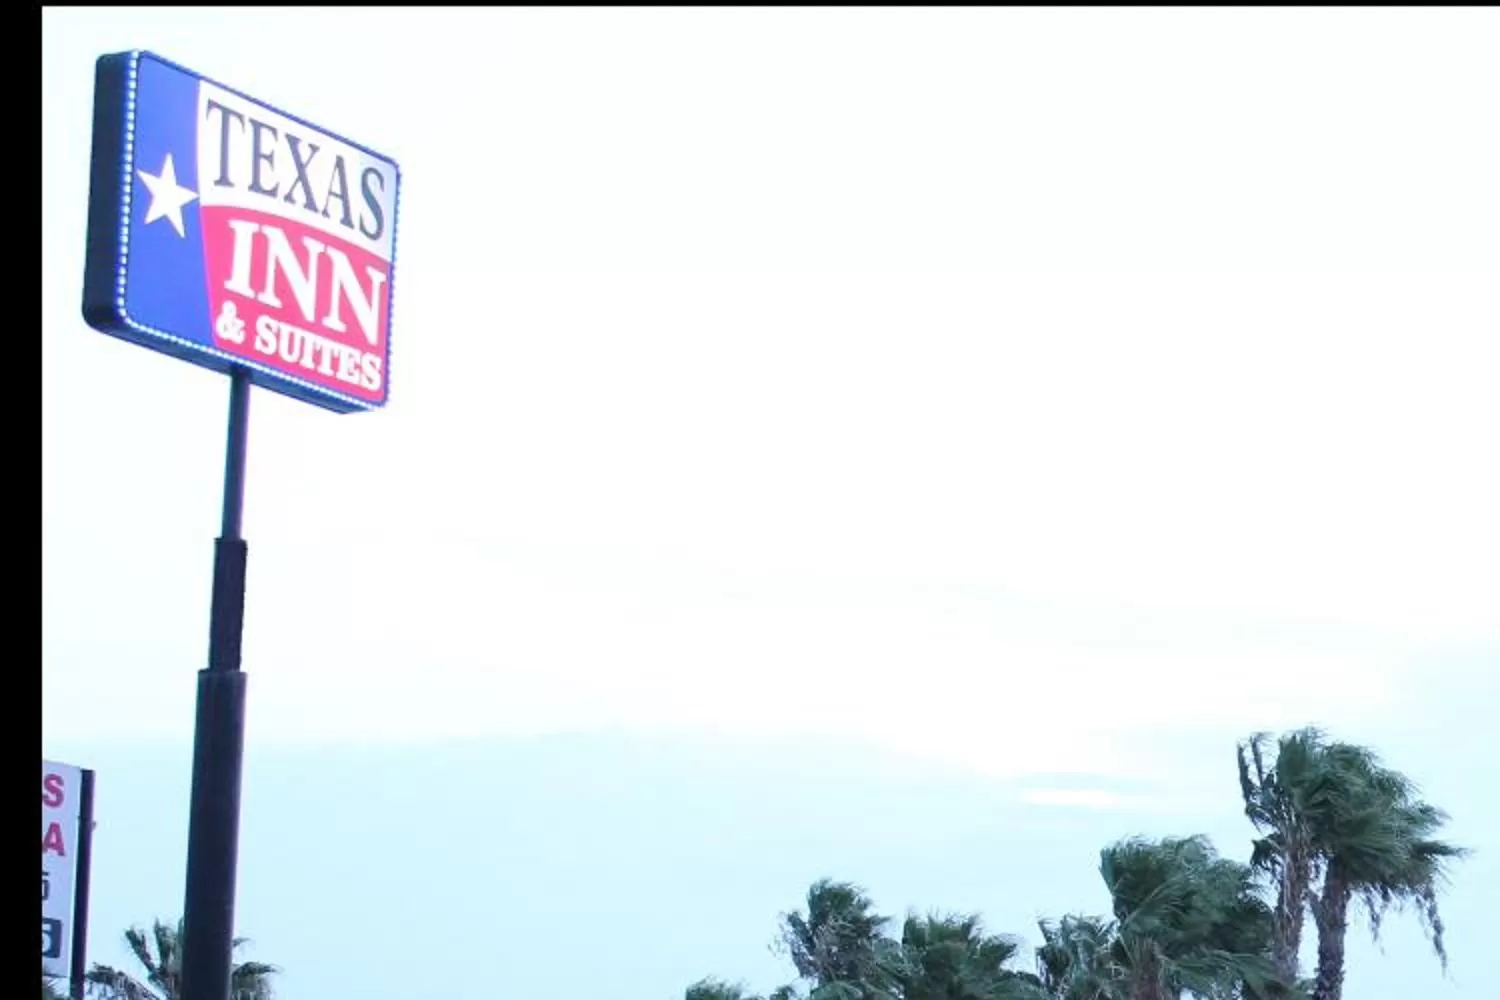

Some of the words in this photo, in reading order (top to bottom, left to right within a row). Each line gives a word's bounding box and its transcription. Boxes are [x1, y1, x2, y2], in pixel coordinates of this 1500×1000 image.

[206, 97, 386, 241] TEXAS
[214, 299, 247, 346] &
[253, 314, 383, 392] SUITES
[224, 218, 387, 347] INN
